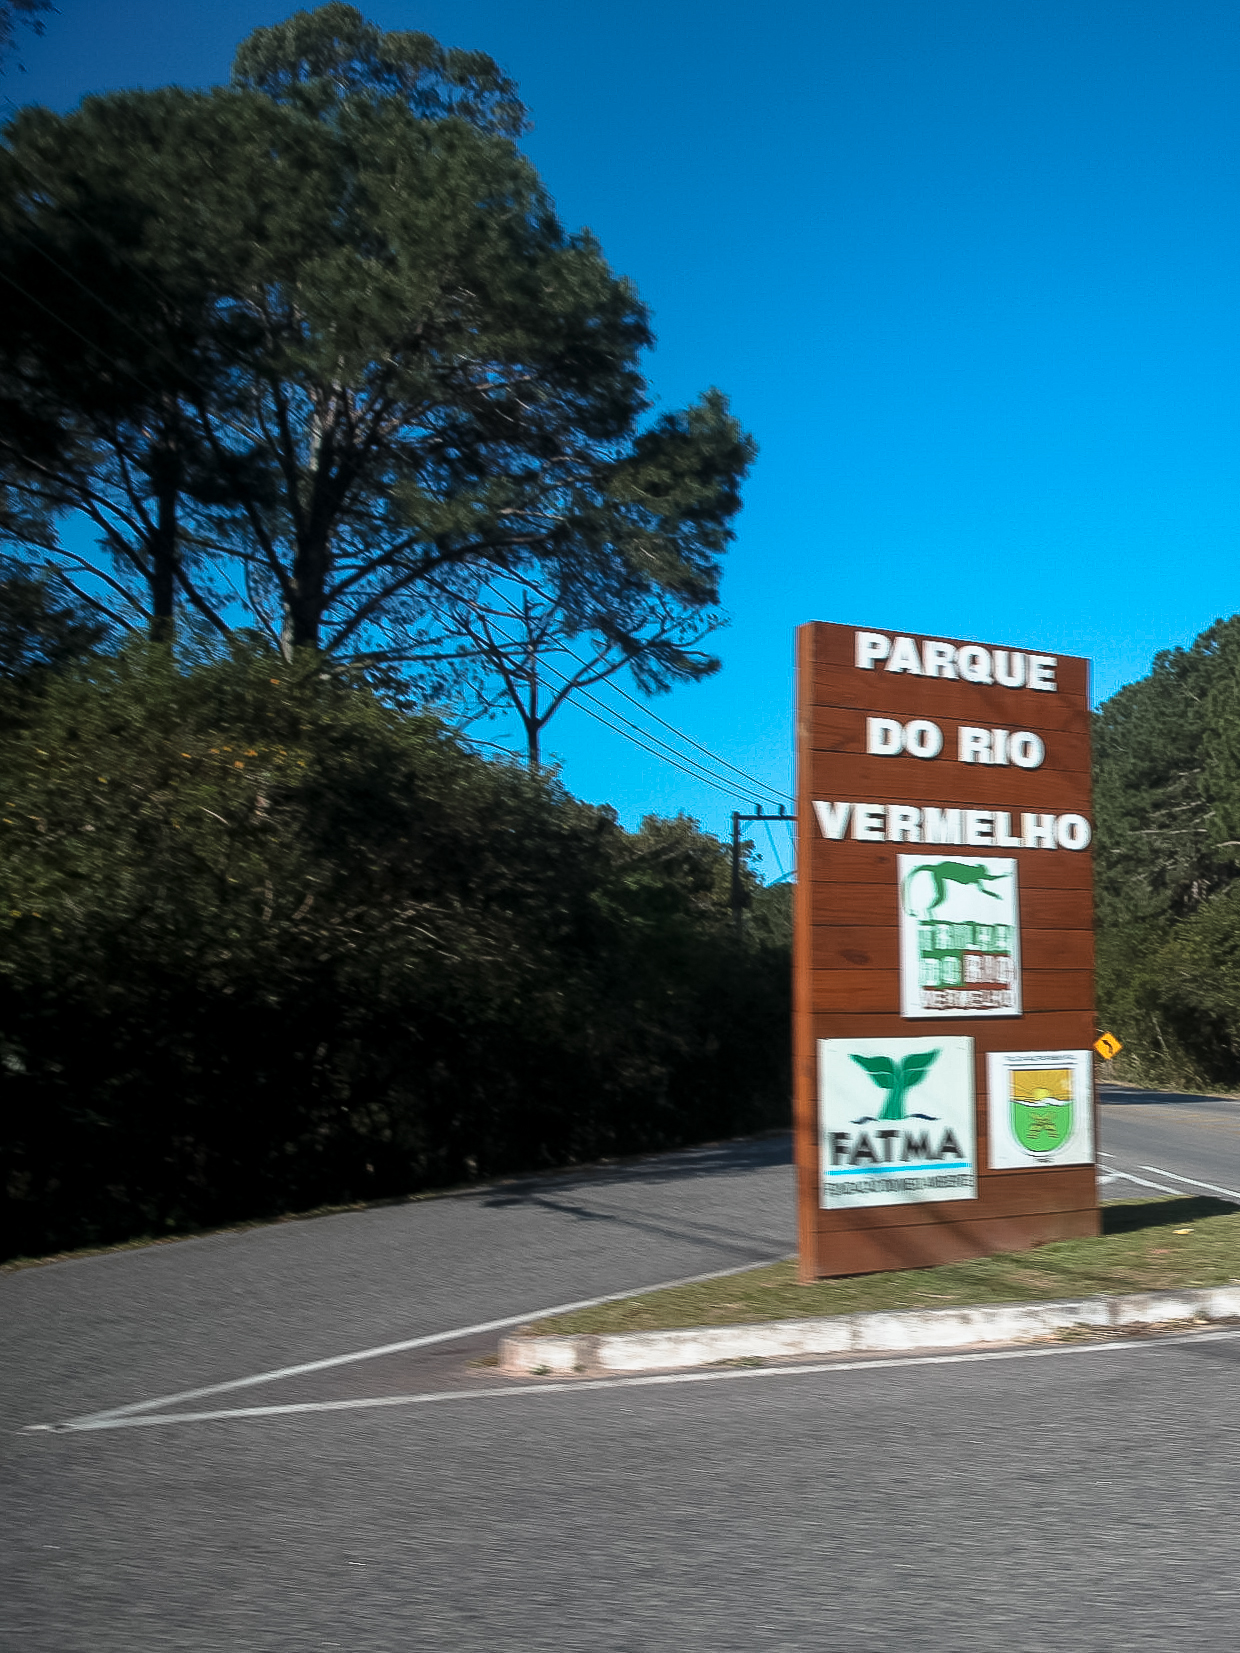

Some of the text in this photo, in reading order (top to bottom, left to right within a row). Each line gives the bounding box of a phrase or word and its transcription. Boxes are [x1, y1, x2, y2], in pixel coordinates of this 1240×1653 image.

[854, 630, 1058, 692] PARQUE
[866, 716, 1046, 769] DO RIO
[812, 800, 1093, 851] VERMELHO
[827, 1126, 966, 1167] FATMA
